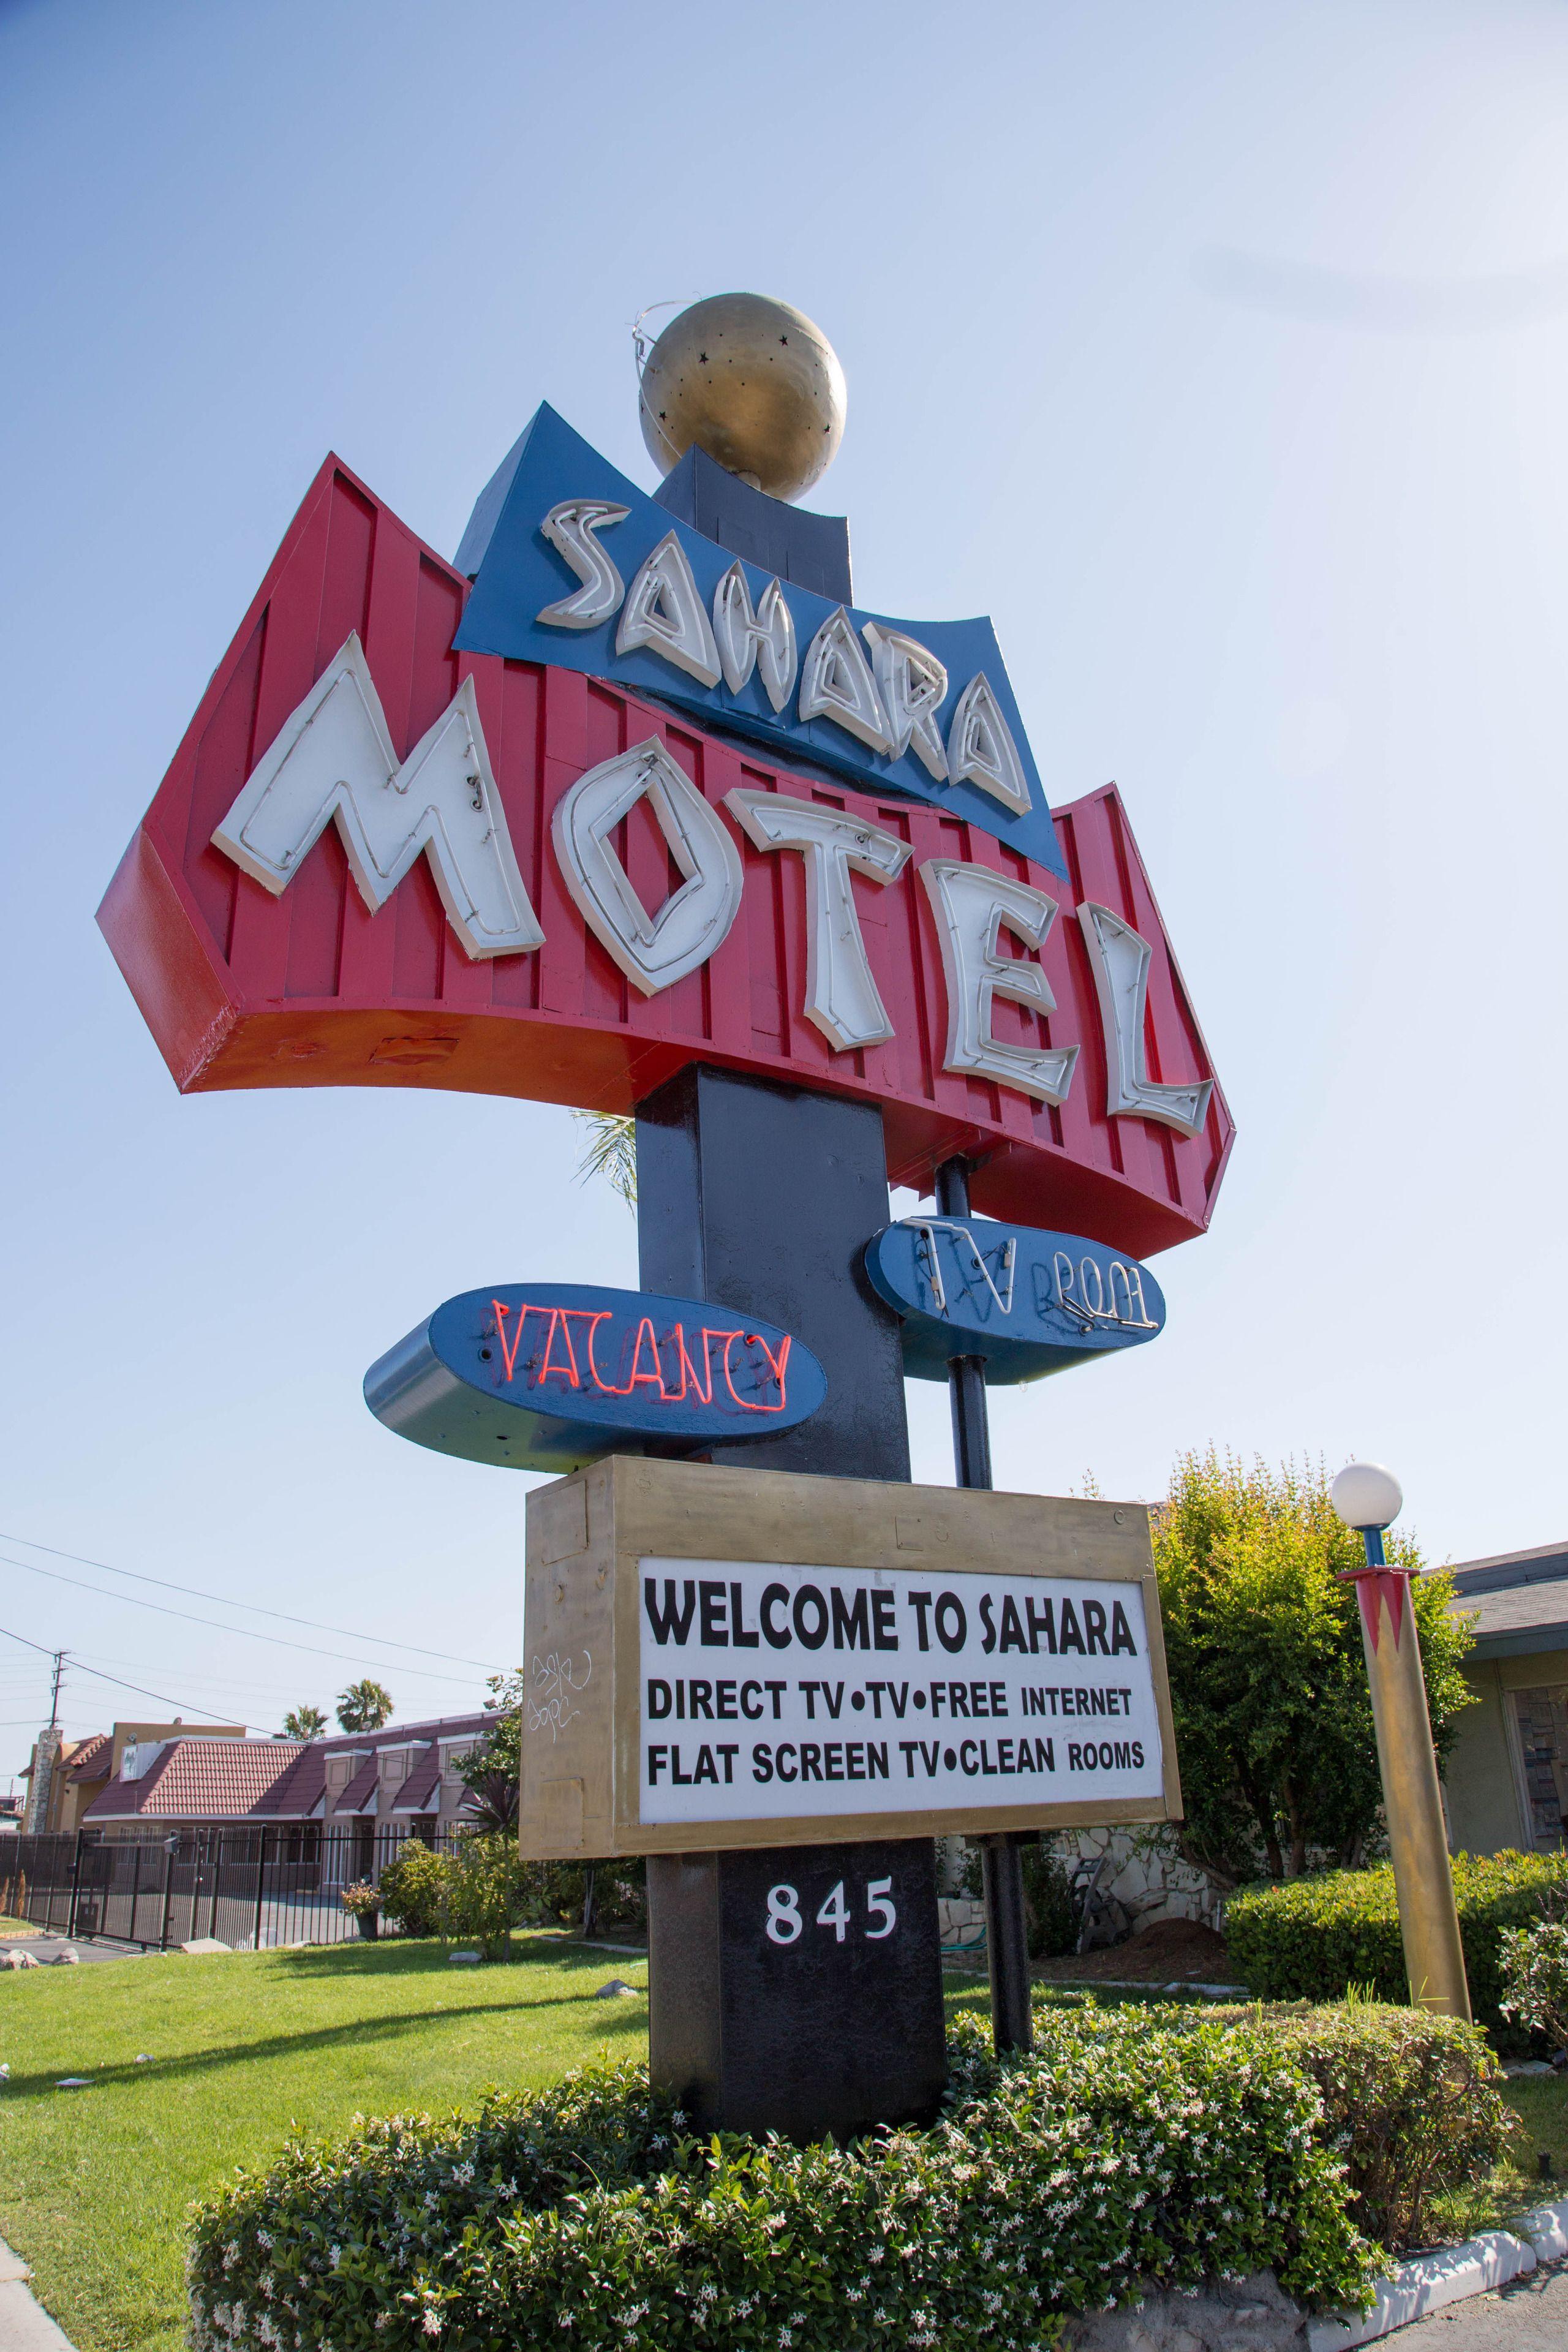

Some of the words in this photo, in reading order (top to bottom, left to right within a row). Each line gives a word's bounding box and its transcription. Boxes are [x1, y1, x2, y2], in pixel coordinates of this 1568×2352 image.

[535, 499, 1032, 817] SAHARA
[210, 630, 1215, 1138] MOTEL
[903, 1216, 1017, 1315] TV
[492, 1299, 791, 1411] VACANCY
[645, 1578, 899, 1651] WELCOME
[908, 1591, 967, 1654] TO
[979, 1594, 1138, 1656] SAHARA
[647, 1679, 787, 1720] DIRECT
[798, 1681, 845, 1719] TV
[1021, 1687, 1132, 1716] INTERNET
[647, 1744, 739, 1786] FLAT
[752, 1741, 889, 1784] SCREEN
[1068, 1741, 1145, 1771] ROOMS
[766, 1875, 897, 1946] 845
